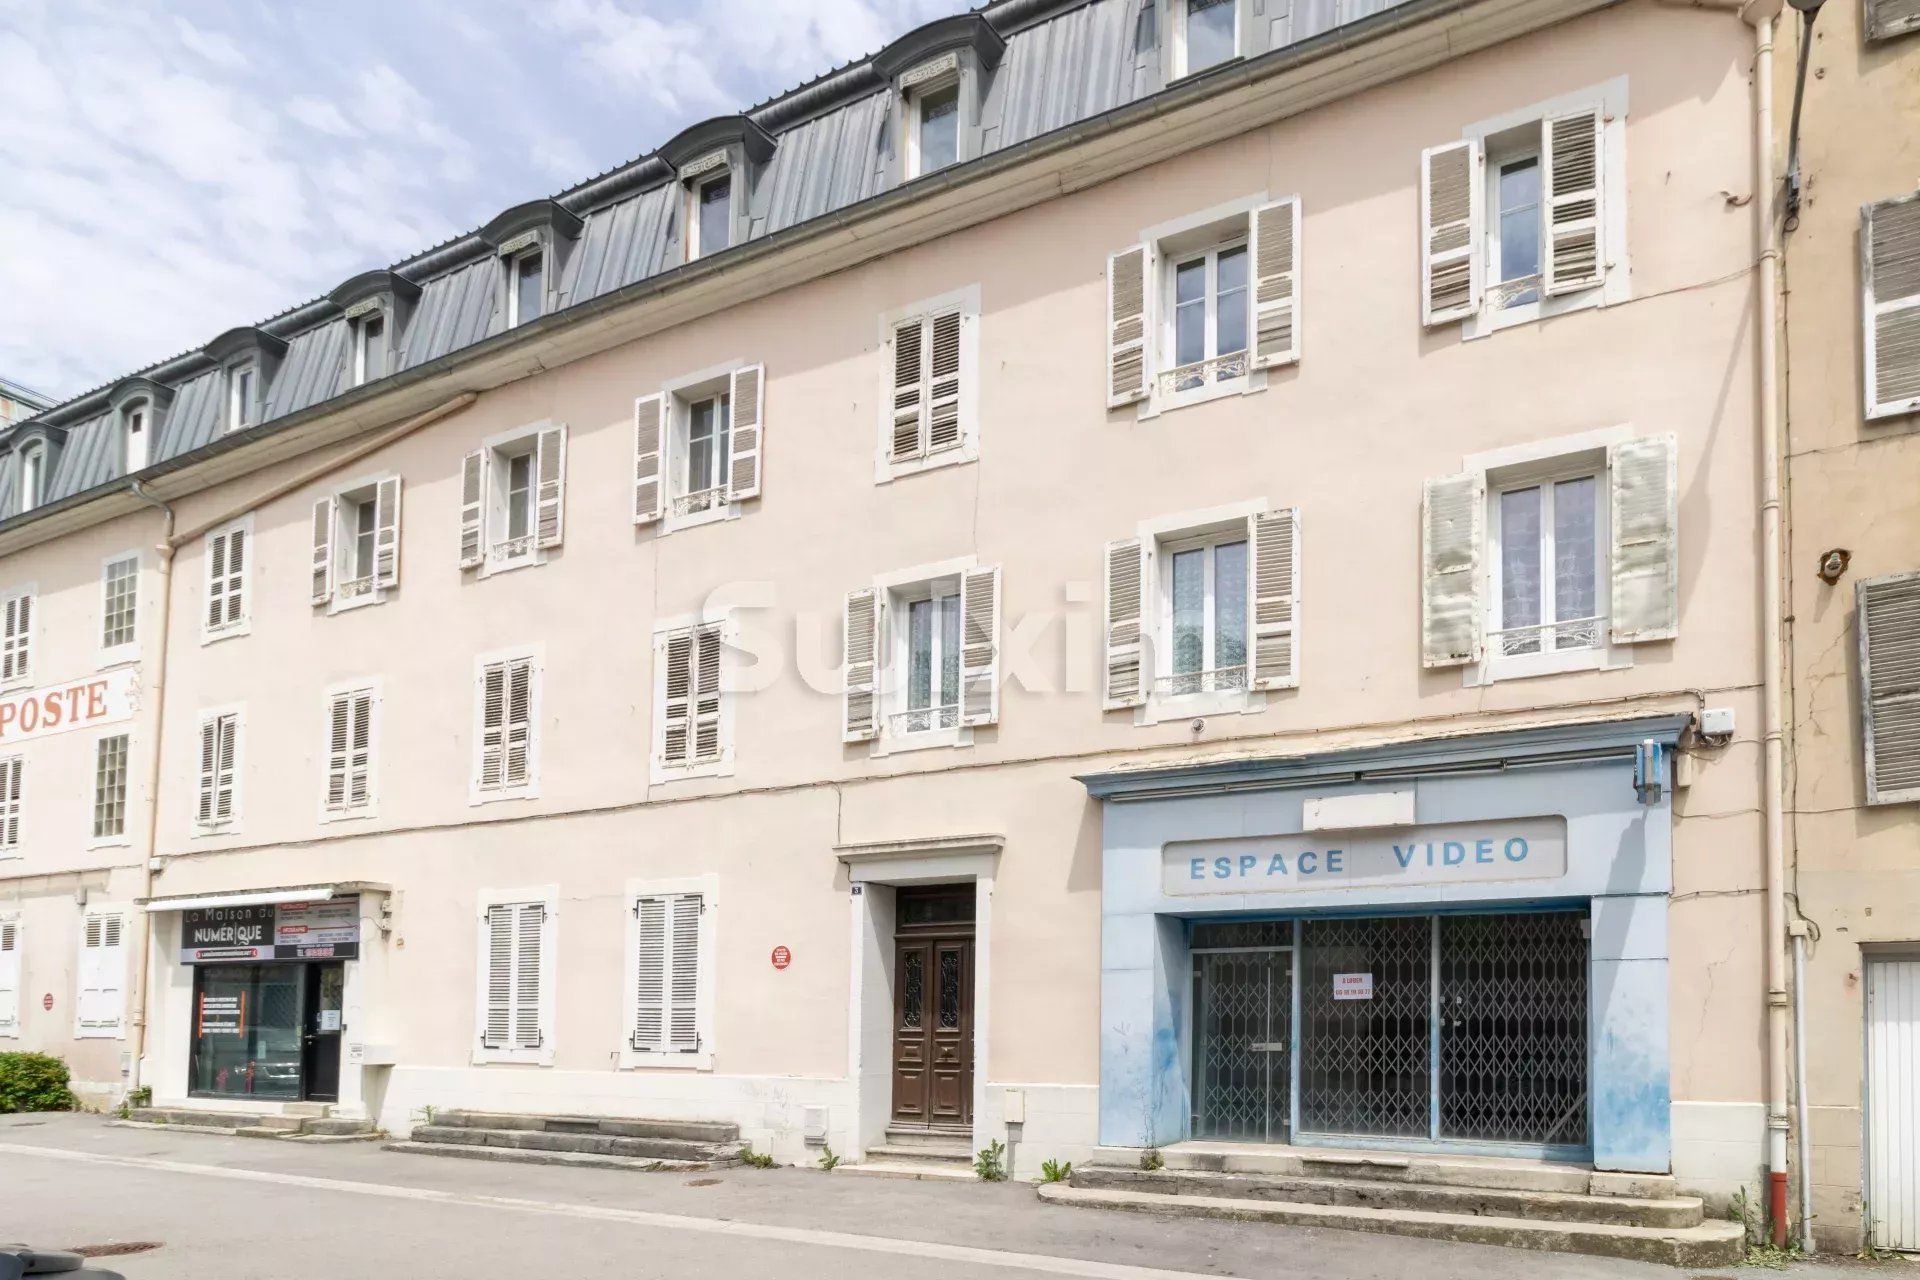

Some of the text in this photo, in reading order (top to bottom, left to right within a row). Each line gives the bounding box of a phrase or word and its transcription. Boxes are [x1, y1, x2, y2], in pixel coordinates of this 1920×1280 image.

[0, 680, 108, 737] POSTE
[1190, 837, 1529, 880] ESPACE VIDEO
[185, 910, 199, 923] La
[205, 907, 252, 921] Maison
